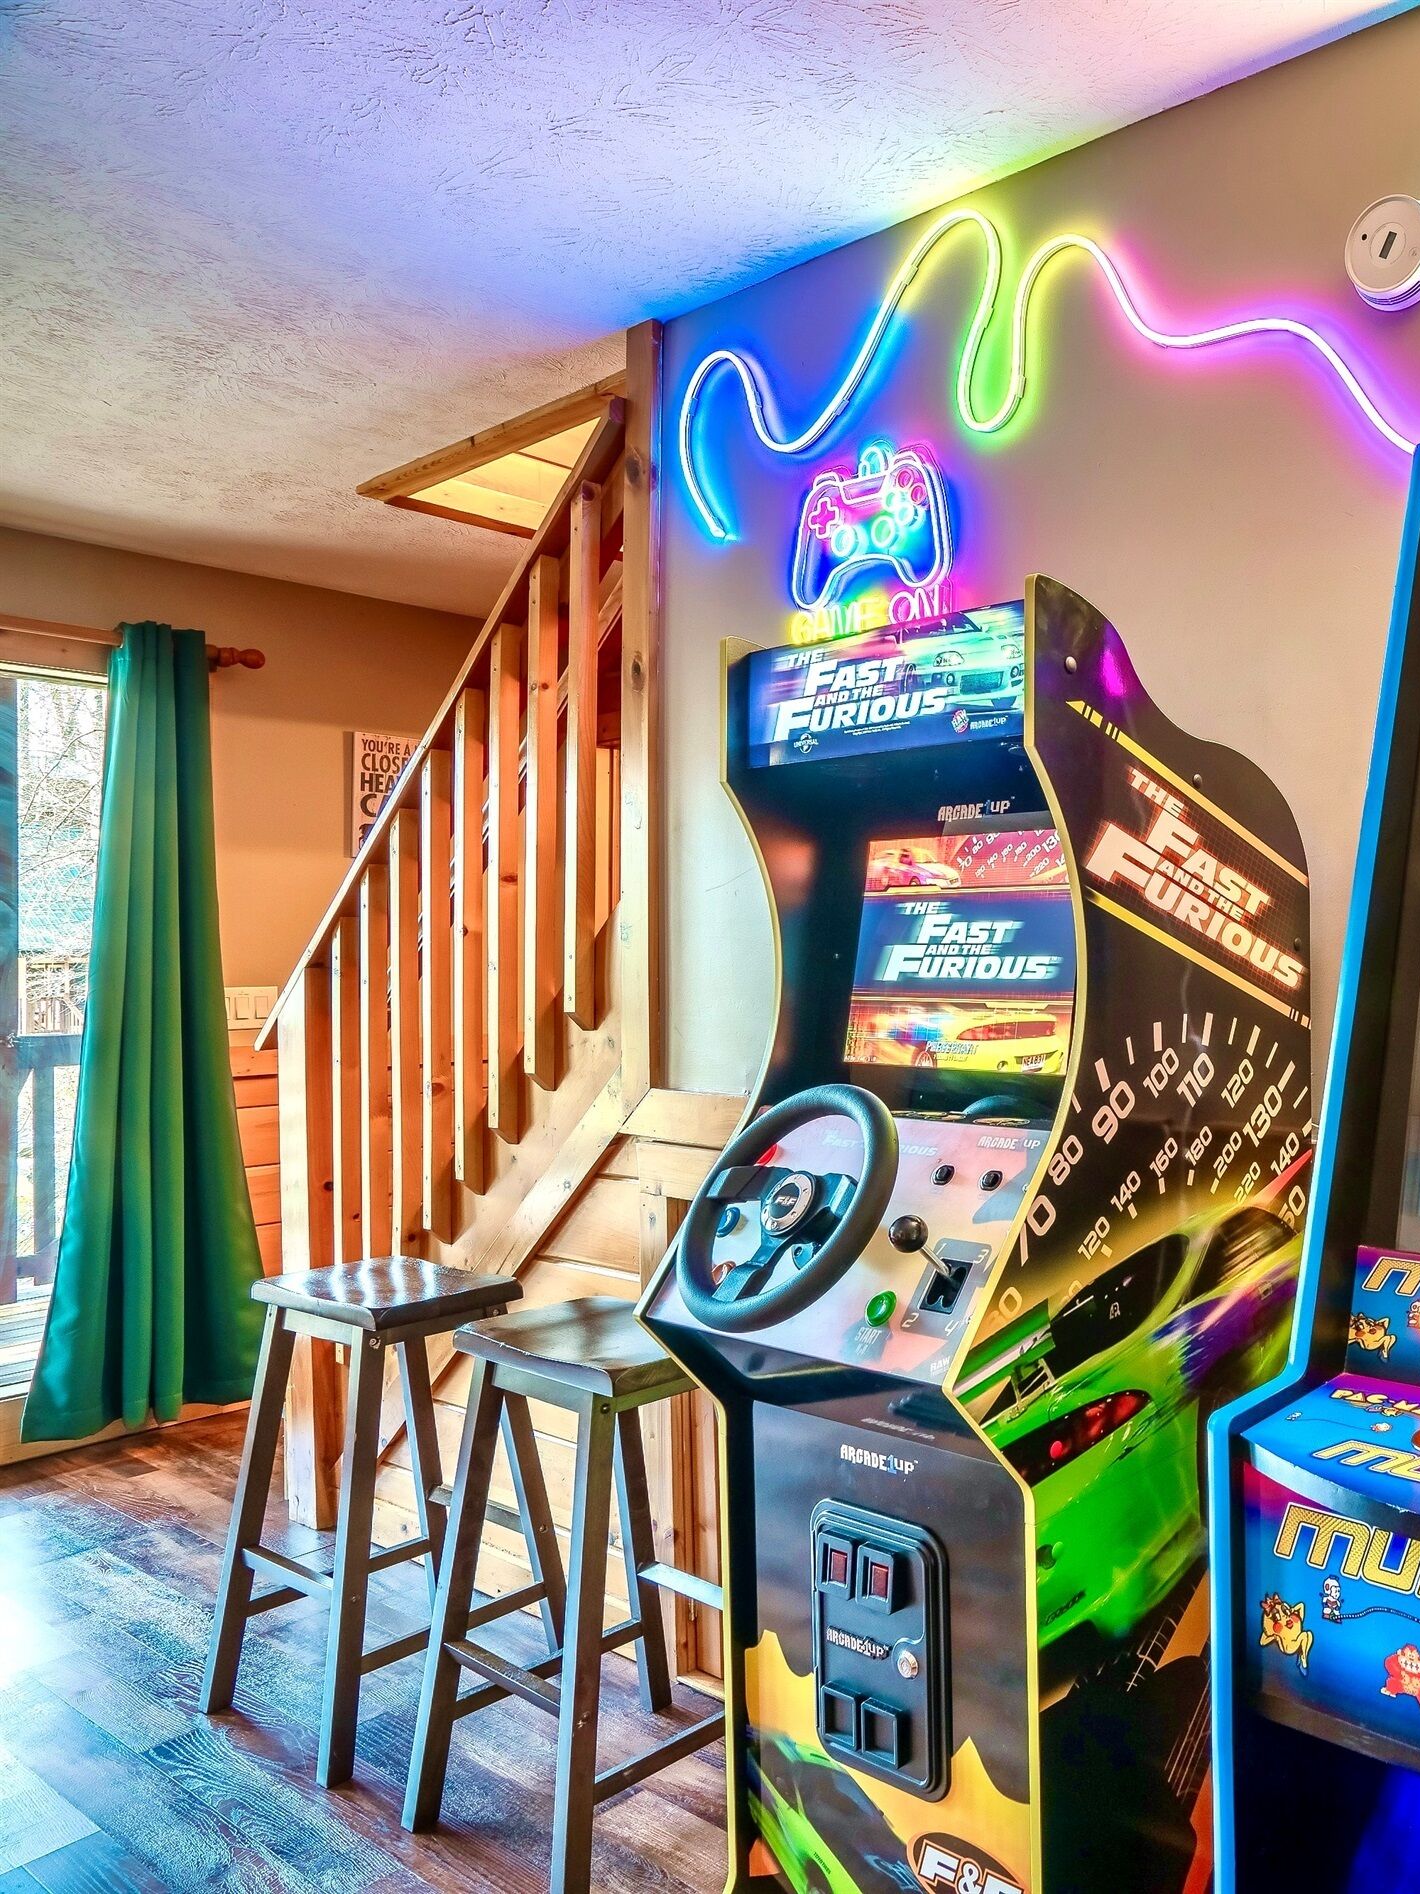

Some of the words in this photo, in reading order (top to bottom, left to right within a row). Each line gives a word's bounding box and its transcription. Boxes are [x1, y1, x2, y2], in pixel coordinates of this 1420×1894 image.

[791, 598, 888, 645] GAME
[786, 648, 827, 667] THE
[802, 656, 905, 697] FAST
[772, 687, 952, 743] FURIOUS
[812, 688, 851, 709] AND
[851, 684, 885, 699] THE
[361, 739, 400, 755] YOU'RE
[403, 743, 411, 757] A
[1130, 768, 1186, 818] THE
[1145, 807, 1271, 916] FAST
[903, 902, 941, 915] THE
[1085, 822, 1304, 988] FURIOUS
[1157, 859, 1206, 896] AND
[1206, 888, 1245, 921] THE
[916, 913, 1014, 945] FAST
[925, 944, 961, 956] AND
[961, 943, 993, 955] THE
[882, 945, 1056, 982] FURIOUS
[1142, 1047, 1179, 1098] 100
[1176, 1052, 1215, 1108] 110
[1220, 1058, 1254, 1109] 120
[1091, 1080, 1135, 1144] 90
[1242, 1084, 1283, 1147] 130
[1047, 1134, 1084, 1186] 80
[1149, 1136, 1179, 1177] 160
[1184, 1125, 1213, 1167] 180
[1212, 1131, 1243, 1179] 200
[1270, 1132, 1300, 1177] 140
[1110, 1170, 1142, 1213] 140
[1233, 1161, 1262, 1205] 220
[973, 1249, 989, 1264] 3
[1077, 1215, 1111, 1261] 120
[854, 1327, 883, 1345] START
[902, 1312, 919, 1328] 2
[944, 1319, 960, 1337] 4
[840, 1443, 915, 1475] ARCADE1UP
